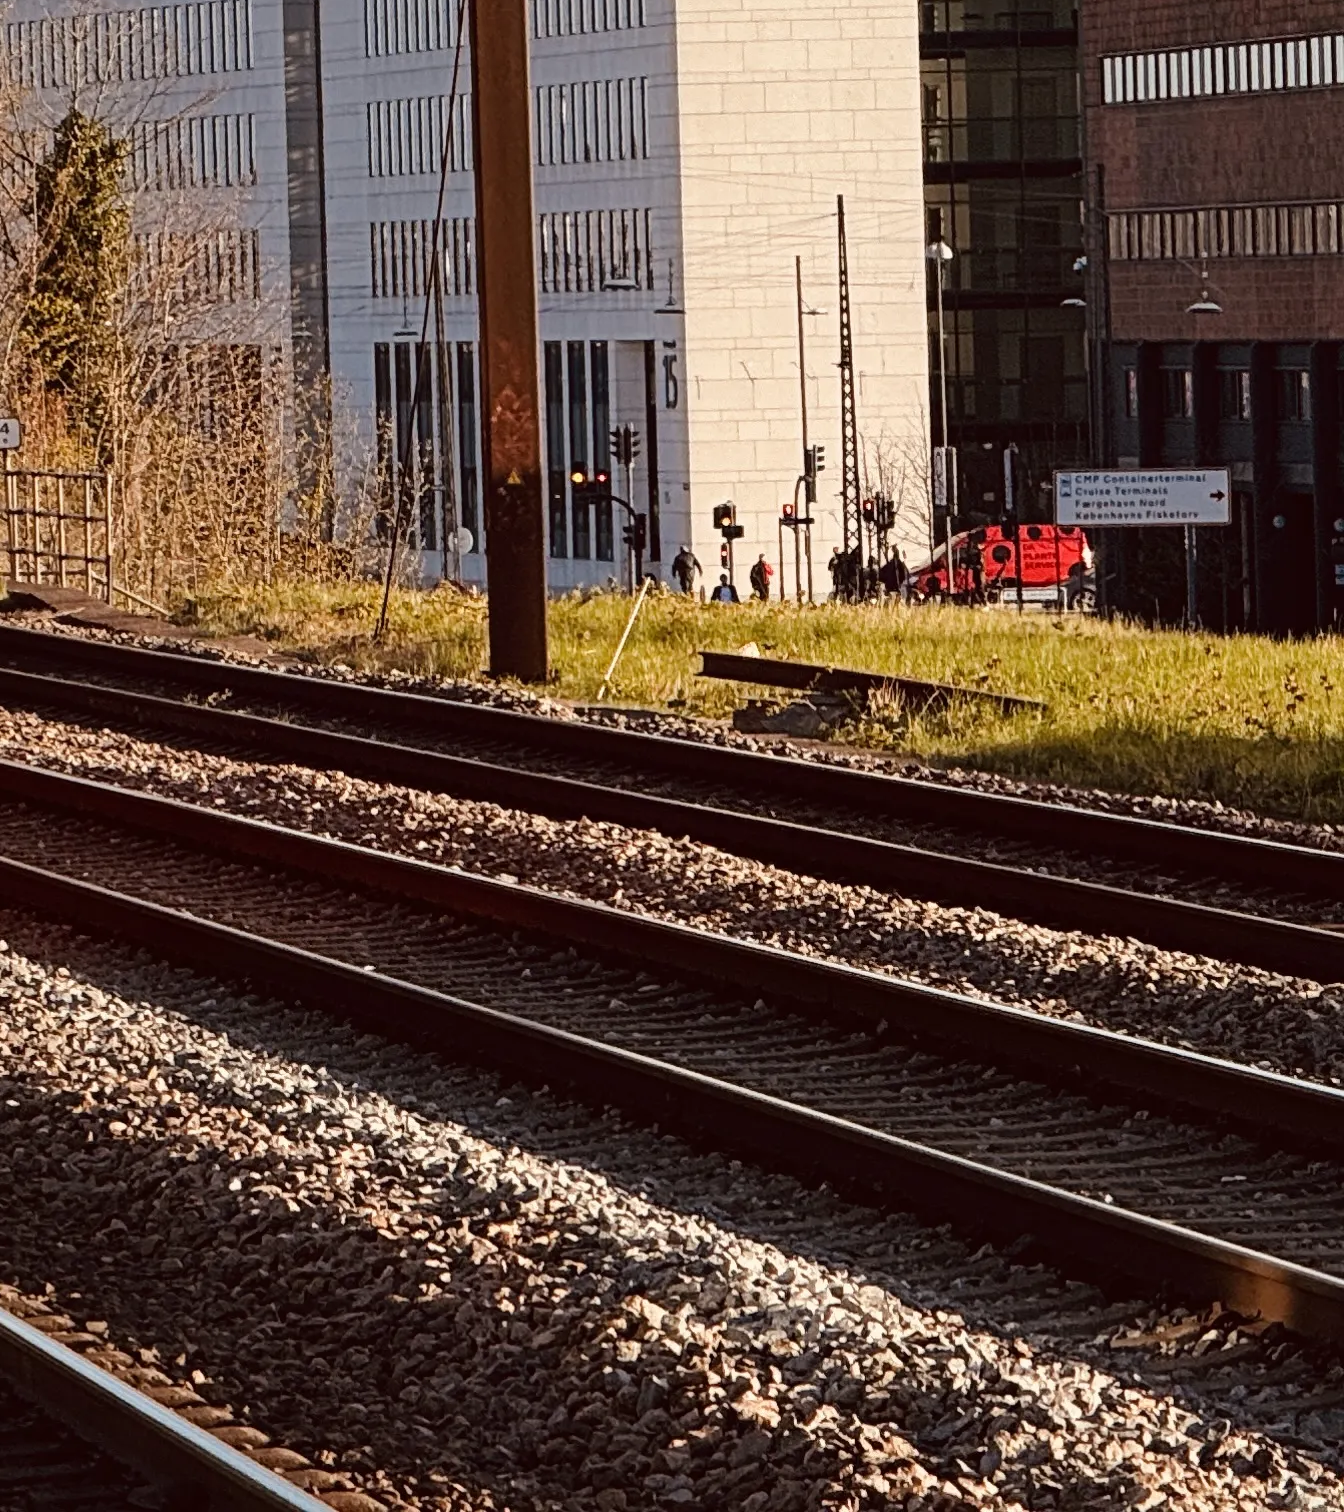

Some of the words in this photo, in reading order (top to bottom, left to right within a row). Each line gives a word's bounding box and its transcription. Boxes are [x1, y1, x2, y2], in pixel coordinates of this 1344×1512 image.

[0, 422, 10, 434] 4
[1075, 475, 1099, 484] CMP
[1103, 473, 1207, 483] Containerterminal
[1075, 487, 1111, 496] Cruise
[1115, 486, 1169, 495] Terminals
[1139, 498, 1166, 507] Nord
